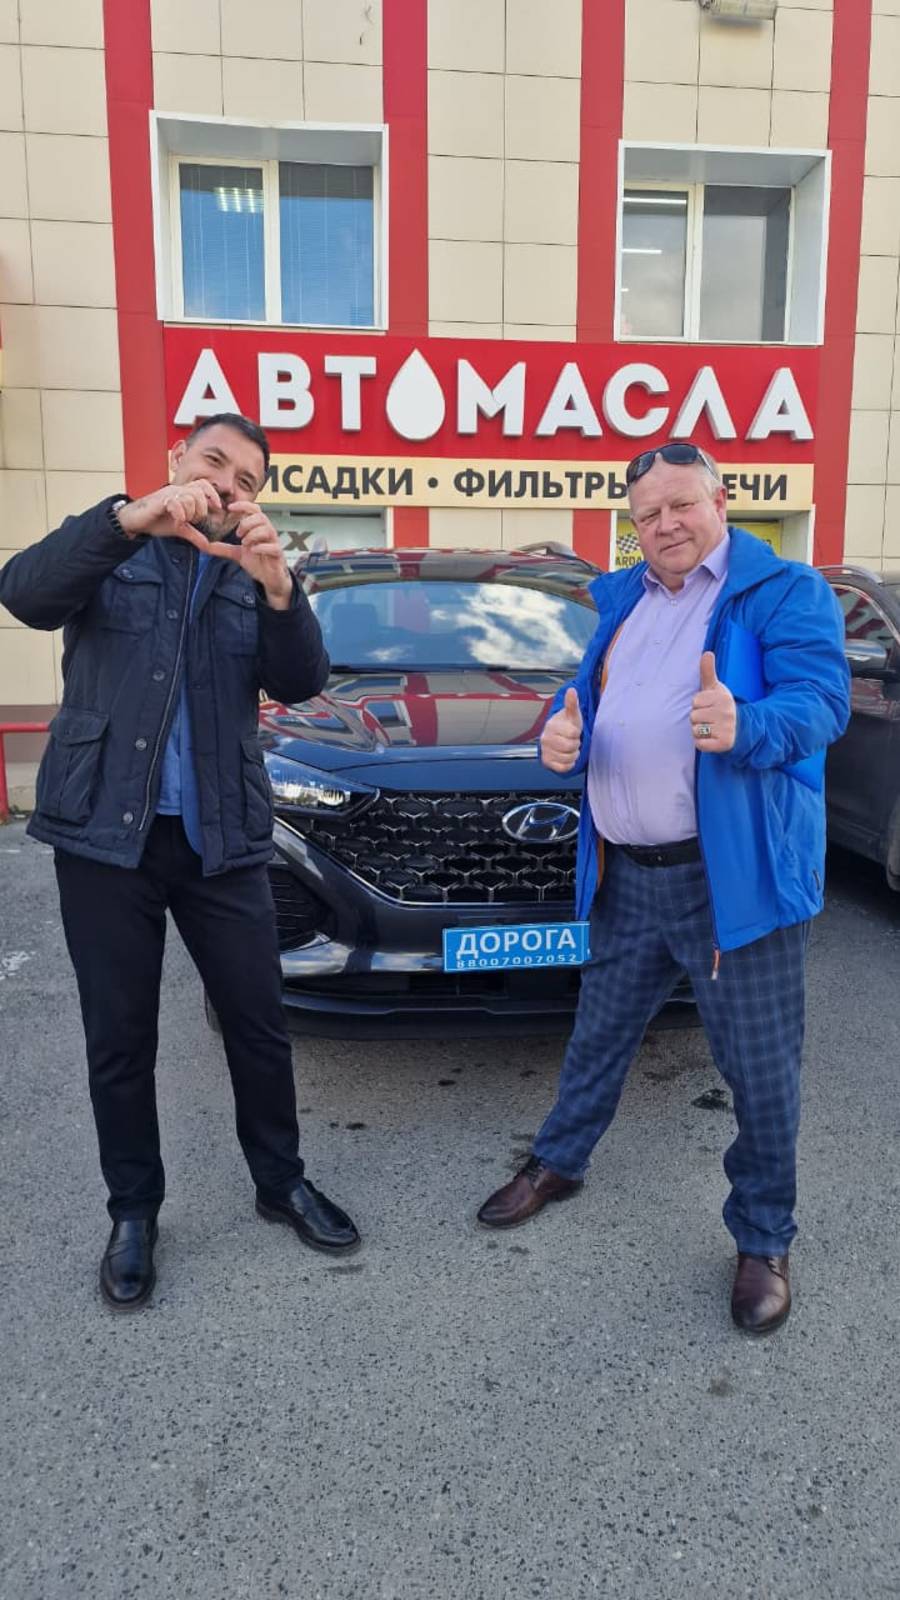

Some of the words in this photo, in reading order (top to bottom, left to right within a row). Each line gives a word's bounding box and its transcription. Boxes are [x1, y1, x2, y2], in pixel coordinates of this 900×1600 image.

[266, 464, 413, 499] ИСАДКИ
[722, 473, 788, 501] ЕЧИ
[456, 928, 577, 959] ДОРОГА
[456, 953, 577, 969] 88007007052
